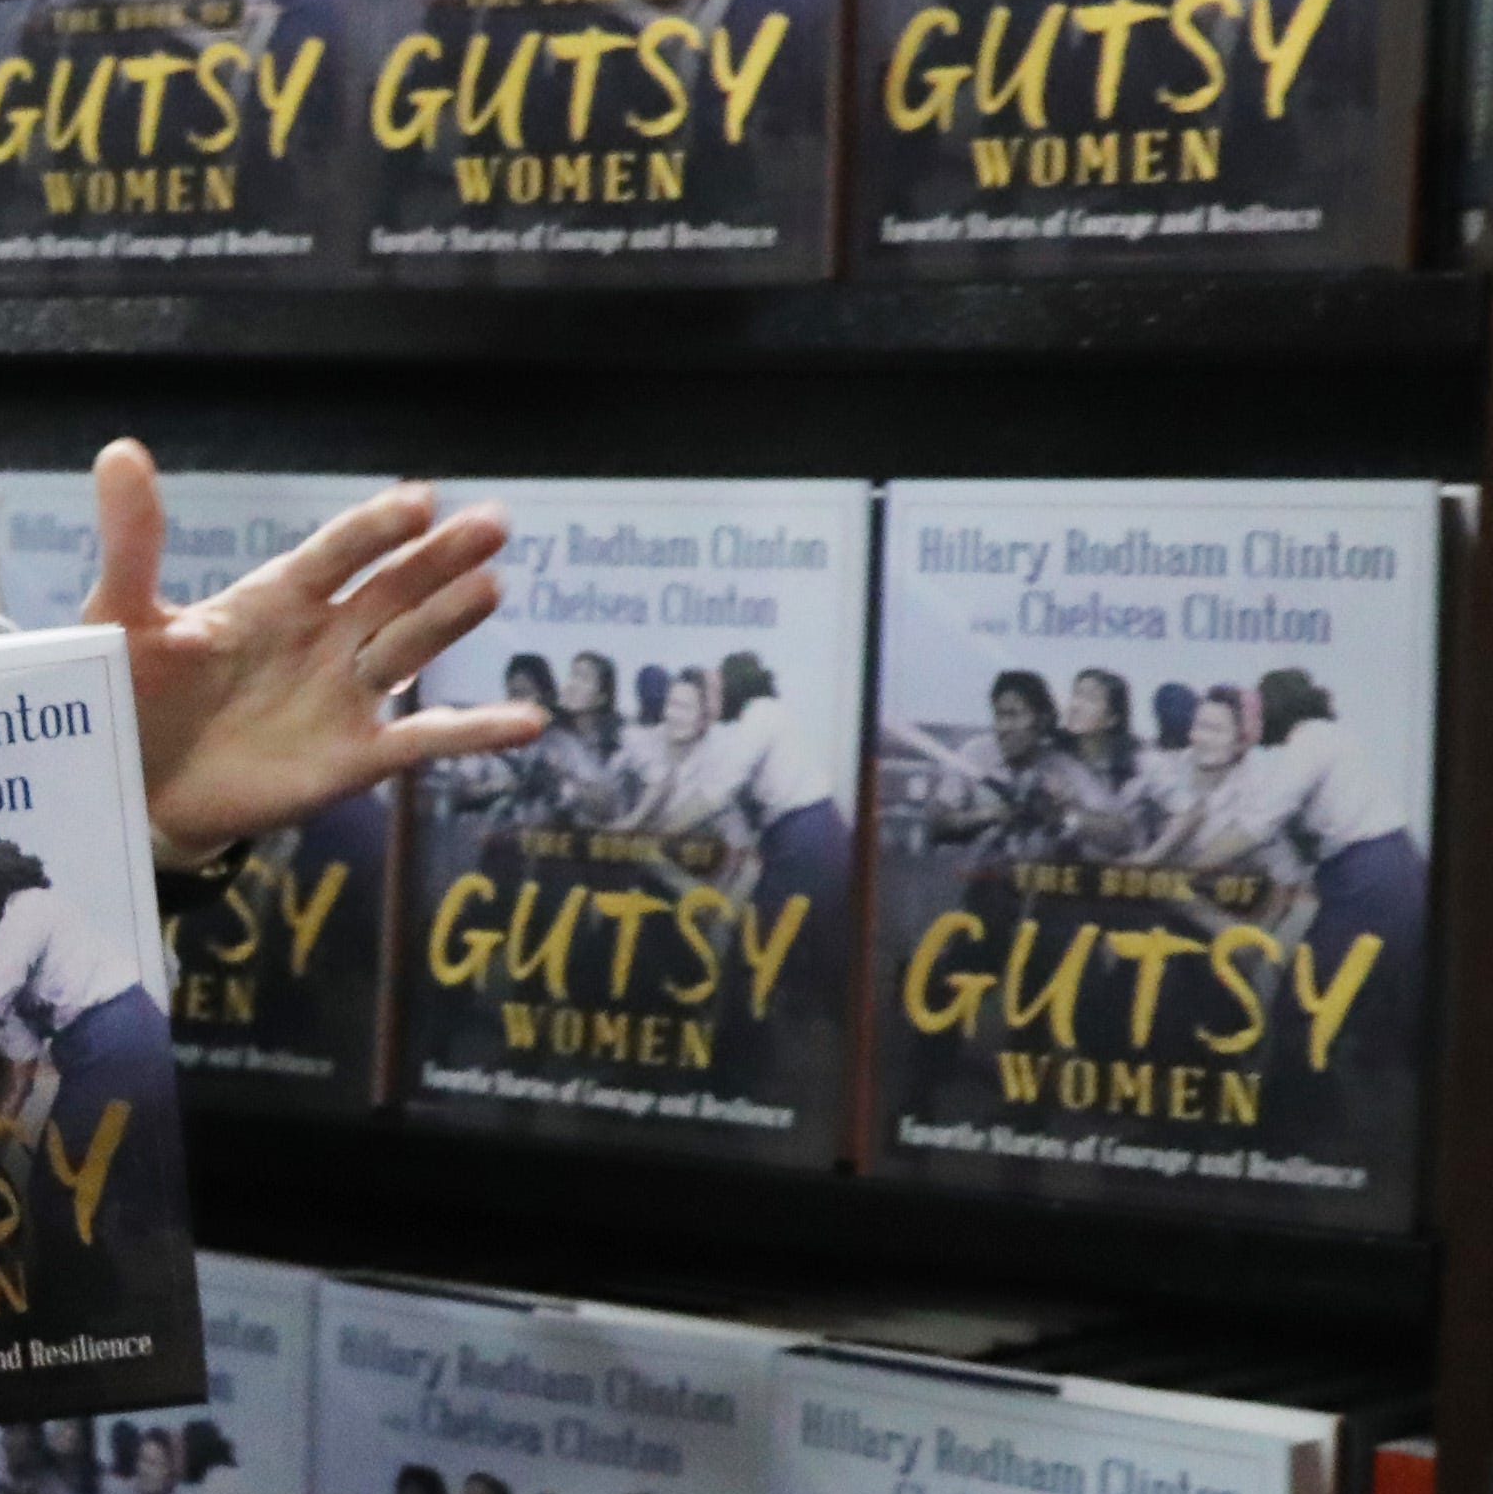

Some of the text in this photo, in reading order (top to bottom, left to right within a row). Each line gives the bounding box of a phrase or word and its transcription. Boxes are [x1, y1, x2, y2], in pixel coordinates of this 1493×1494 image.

[372, 14, 789, 146] GUTSY
[40, 164, 238, 214] WOMEN
[453, 151, 688, 201] WOMEN
[969, 127, 1224, 189] WOMEN
[918, 528, 1393, 586] Hillary Rodham Clinton
[1021, 591, 1330, 643] Chelsea Clinton
[425, 876, 810, 1018] GUTSY
[902, 912, 1380, 1071] GUTSY
[499, 1003, 717, 1070] WOMEN
[995, 1050, 1265, 1127] WOMEN
[29, 1330, 158, 1366] Resilience
